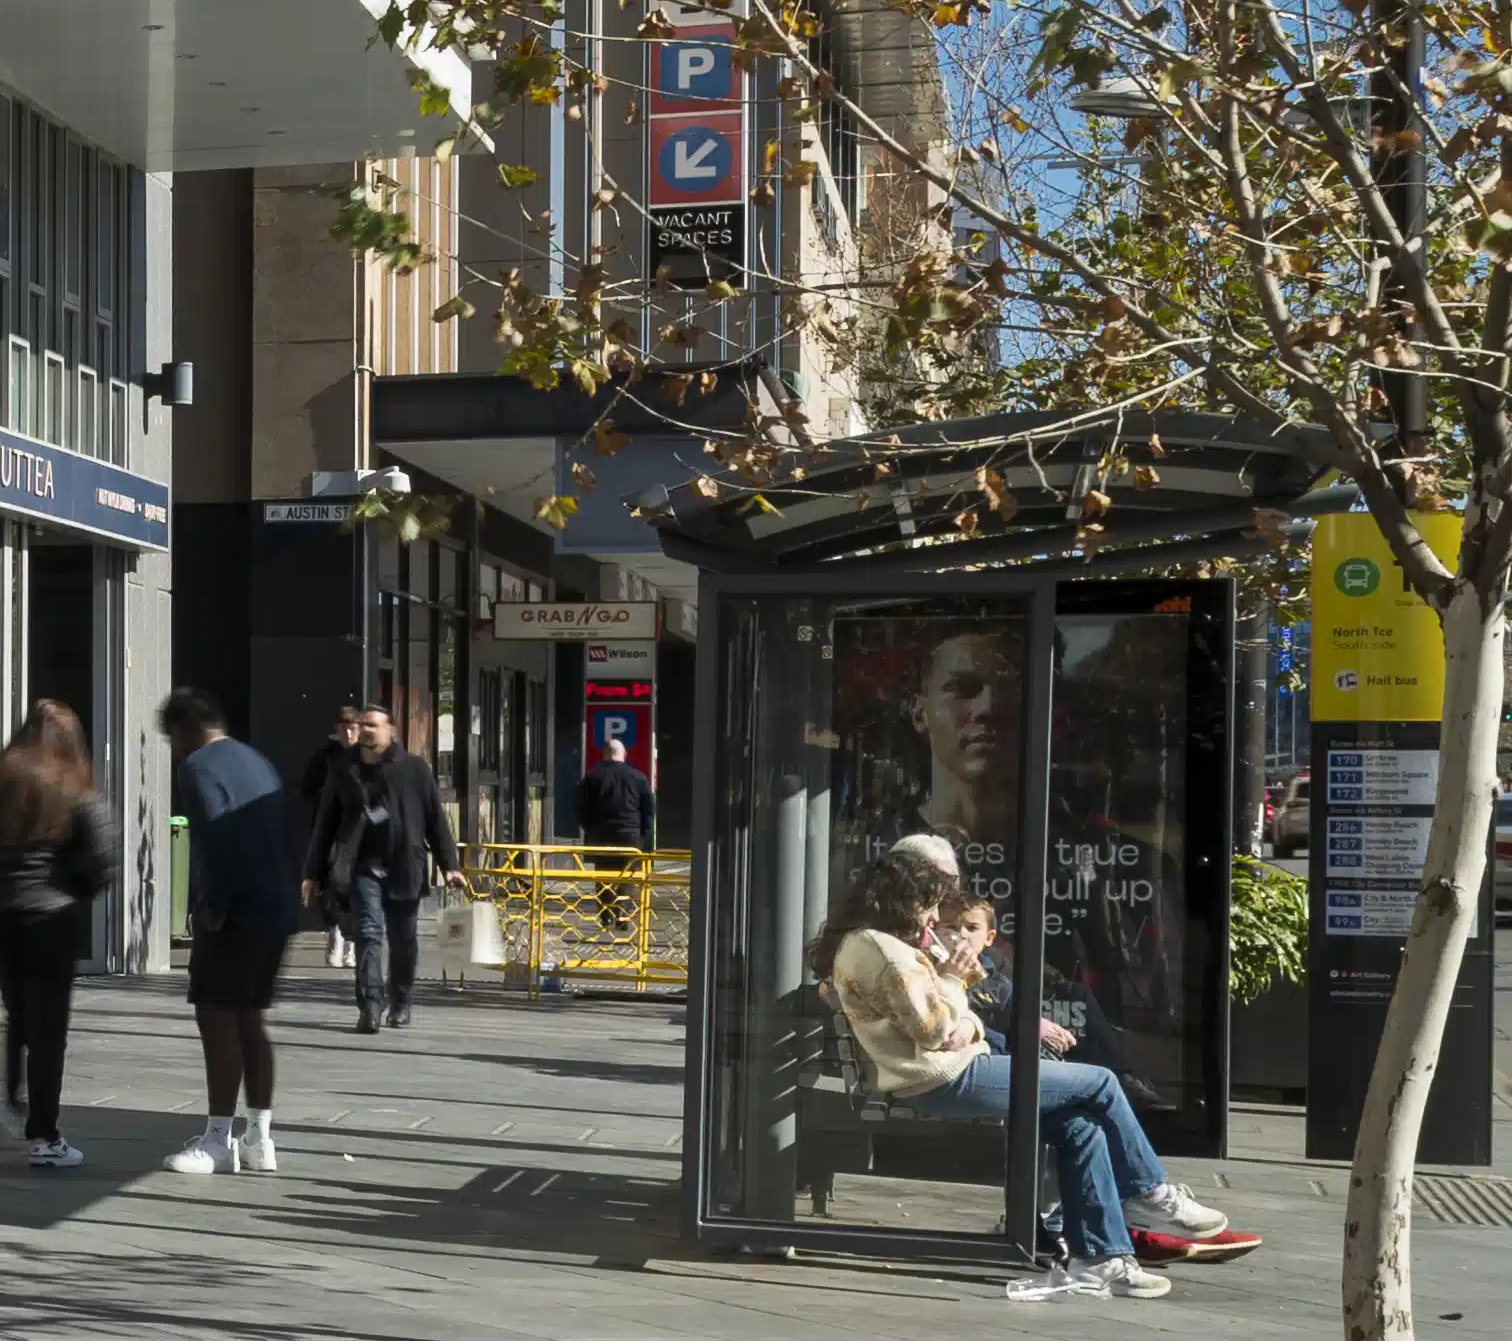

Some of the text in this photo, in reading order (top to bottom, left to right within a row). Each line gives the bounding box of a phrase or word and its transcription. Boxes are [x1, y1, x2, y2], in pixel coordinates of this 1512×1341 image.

[678, 48, 715, 89] P
[658, 211, 732, 229] VACANT
[658, 230, 732, 248] SPACES
[286, 506, 328, 520] AUSTIN
[521, 610, 574, 623] GRAB
[1333, 627, 1392, 637] North Tce
[1394, 676, 1418, 686] bus
[604, 717, 627, 741] P
[1336, 756, 1358, 766] 170
[1335, 773, 1357, 783] 171
[1335, 789, 1357, 799] 172
[1055, 838, 1139, 866] true
[972, 874, 1012, 900] to
[1106, 879, 1154, 907] up
